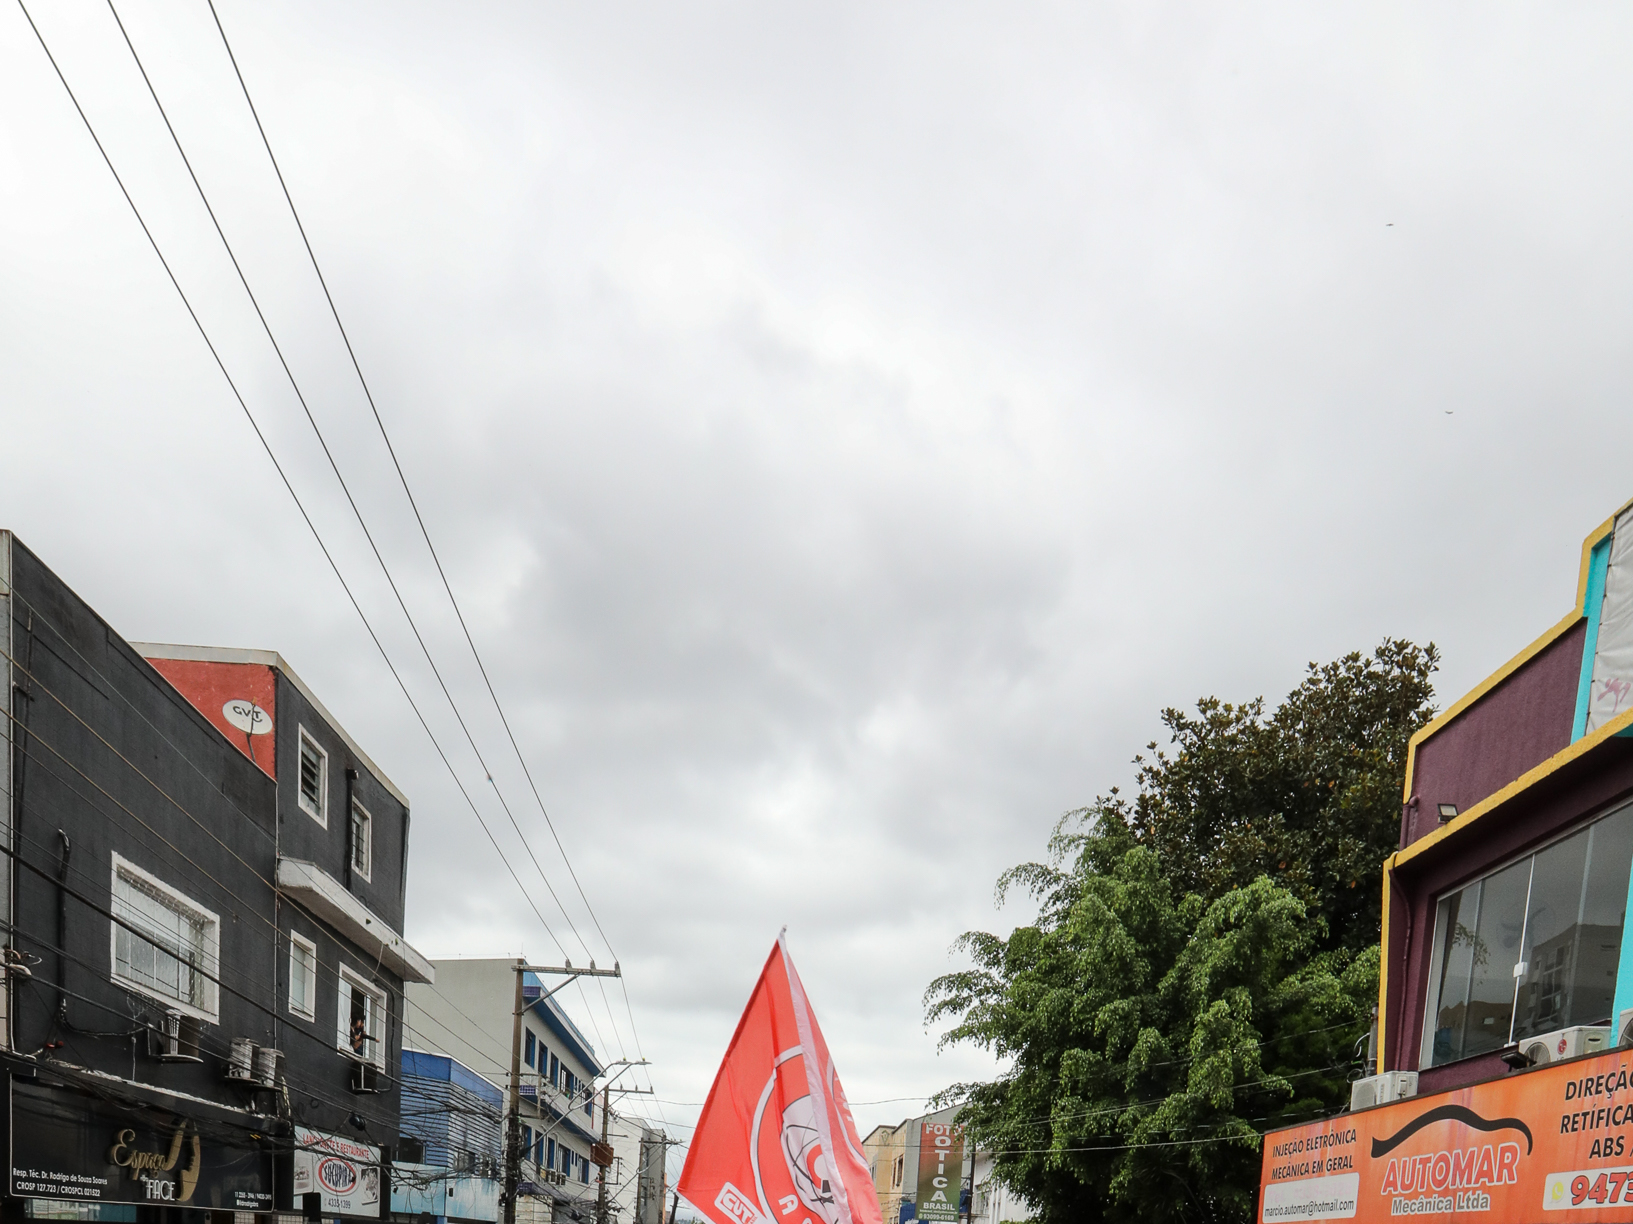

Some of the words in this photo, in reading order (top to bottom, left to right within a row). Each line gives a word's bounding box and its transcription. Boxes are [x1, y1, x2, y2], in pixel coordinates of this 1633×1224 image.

[233, 705, 262, 720] GVT
[111, 1129, 167, 1180] Espaço
[1272, 1138, 1304, 1158] INJEÇÃO
[1305, 1129, 1357, 1152] ELETRÔNICA
[1589, 1136, 1625, 1159] ABS
[13, 1168, 28, 1178] Resp.
[50, 1172, 69, 1182] Rodrigo
[70, 1174, 77, 1182] de
[1271, 1162, 1310, 1180] MECÂNICA
[1311, 1160, 1324, 1174] EM
[1325, 1155, 1354, 1172] GERAL
[1381, 1142, 1520, 1195] AUTOMAR
[16, 1181, 36, 1191] CROSP
[146, 1179, 176, 1201] FACE
[923, 1202, 956, 1211] BRASIL
[1264, 1198, 1354, 1217] marcio.automar@hotmail.com
[1391, 1194, 1453, 1216] Mecânica
[1455, 1190, 1491, 1213] Ltda
